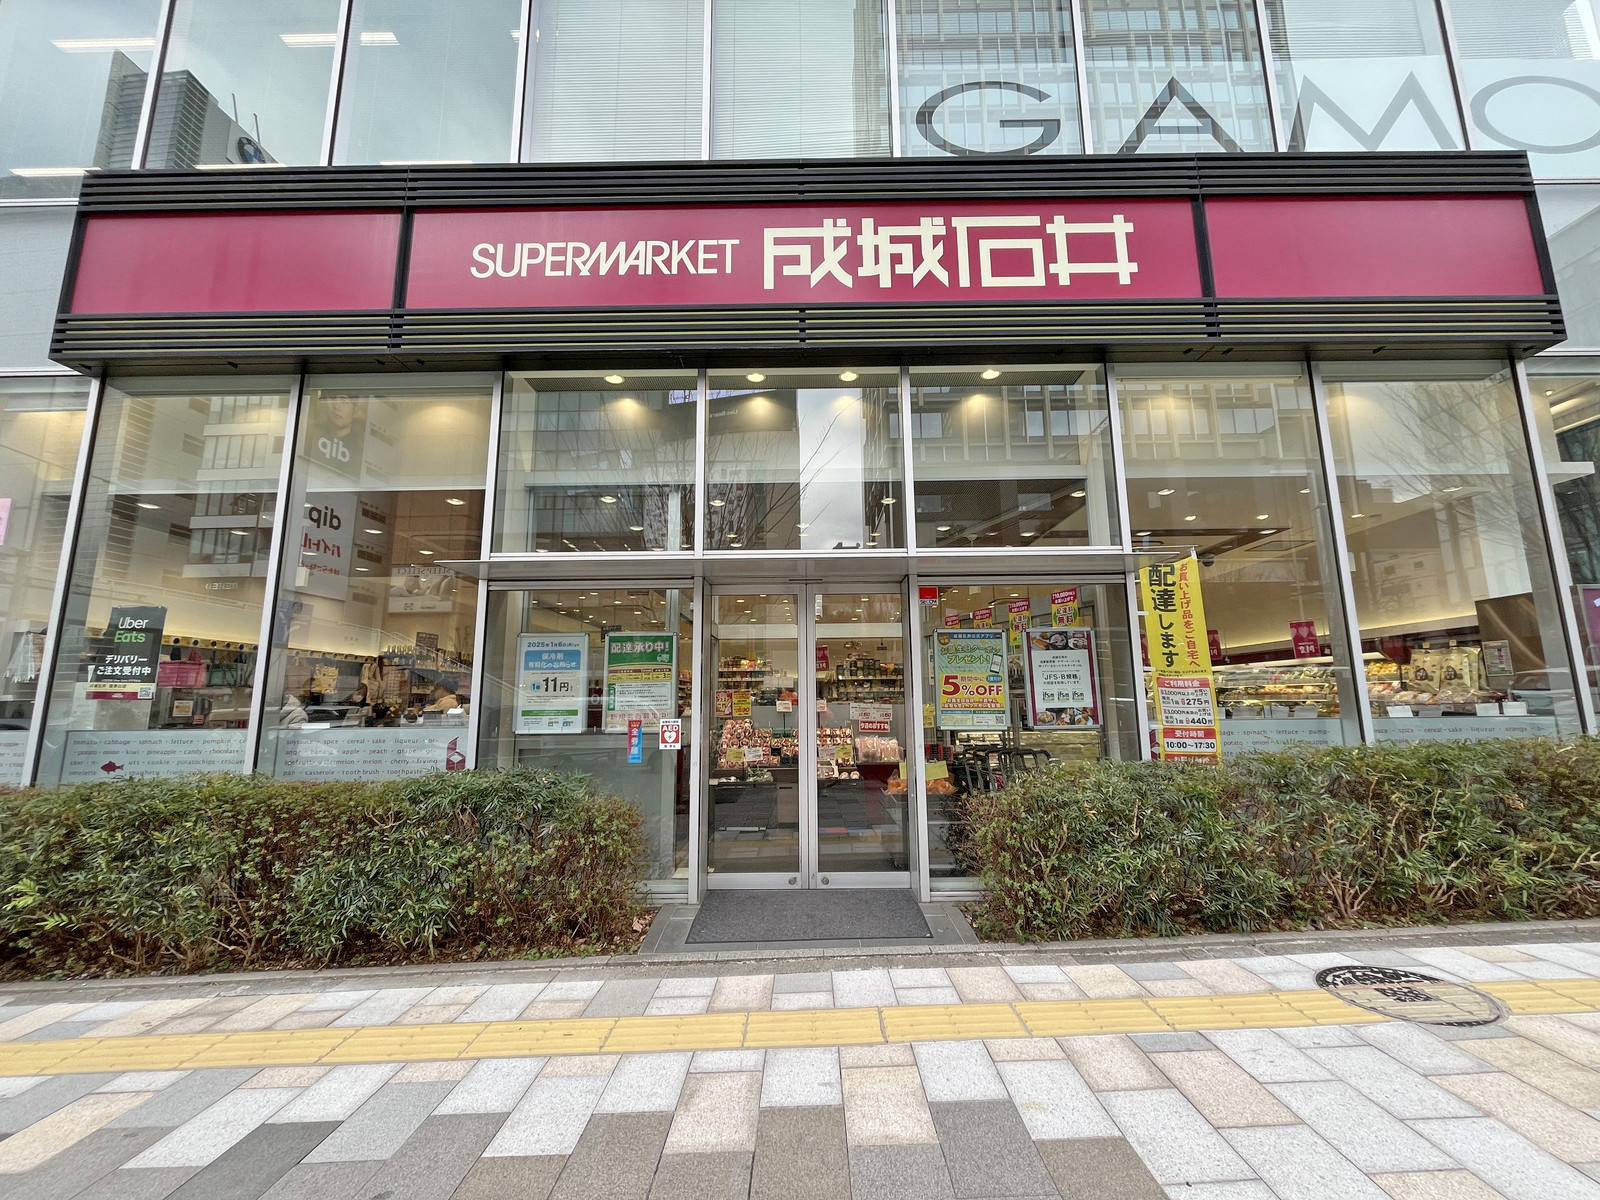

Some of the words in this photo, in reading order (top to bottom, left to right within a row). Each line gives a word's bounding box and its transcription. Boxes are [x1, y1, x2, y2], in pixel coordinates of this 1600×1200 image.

[915, 70, 1600, 155] GAMO
[470, 239, 740, 280] SUPERMARKET
[763, 214, 1138, 290] 成城石井
[1057, 615, 1073, 625] 無料
[1149, 563, 1180, 668] 配達します
[1178, 563, 1201, 668] お買い上げ品をご自宅へ
[118, 617, 149, 628] Uber
[114, 631, 146, 642] Eats
[105, 655, 148, 664] デリバリー
[541, 652, 564, 660] 保冷剤
[947, 655, 990, 664] プレゼント!
[96, 666, 152, 676] ご注文受付中
[542, 676, 570, 692] 11円
[1185, 698, 1210, 706] 275円
[1174, 730, 1205, 738] 受付時間
[104, 738, 131, 746] cabbage
[138, 738, 163, 746] spinach
[184, 748, 202, 756] candy
[342, 748, 360, 756] apple
[390, 758, 409, 766] cherry
[305, 768, 335, 776] casserole
[387, 768, 423, 776] toothpaste
